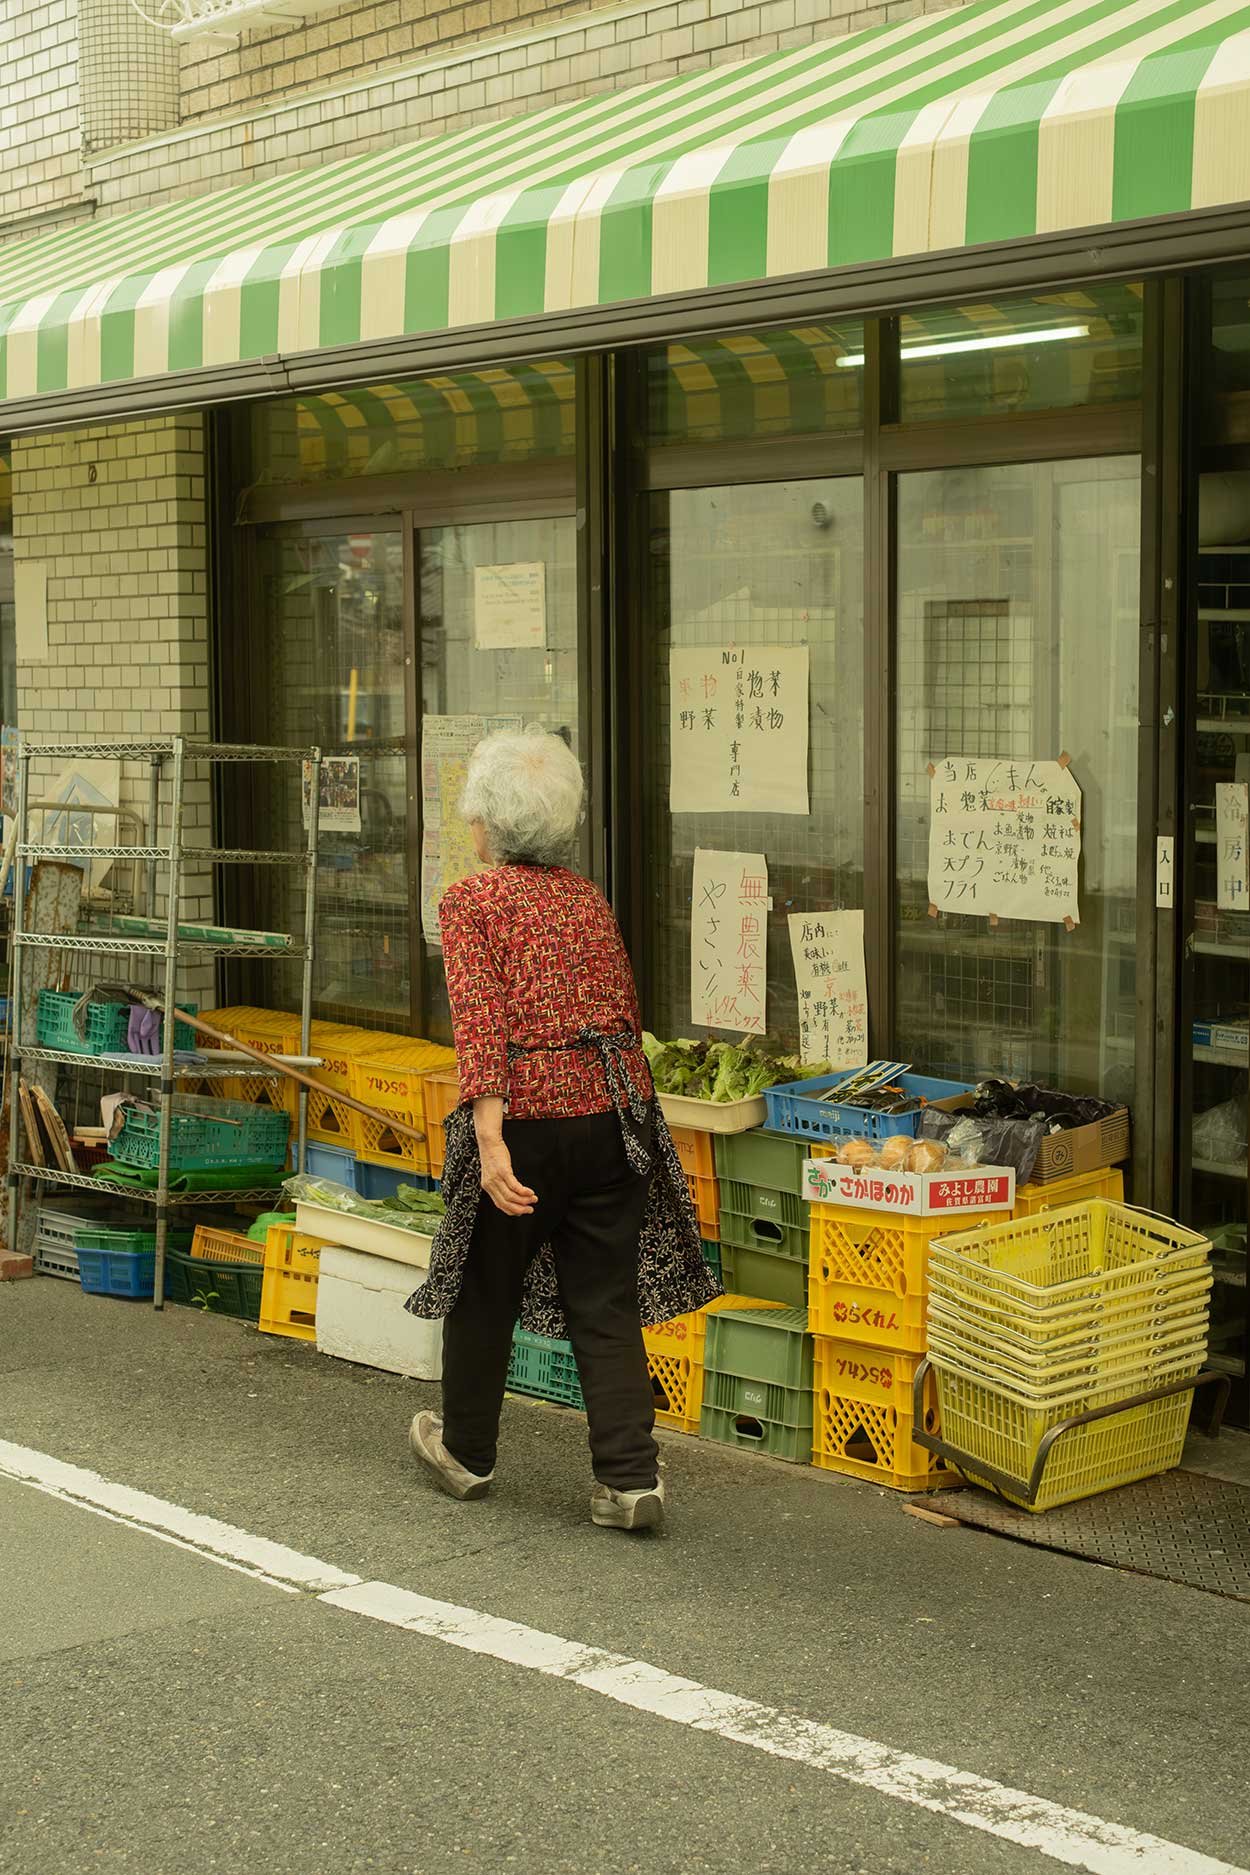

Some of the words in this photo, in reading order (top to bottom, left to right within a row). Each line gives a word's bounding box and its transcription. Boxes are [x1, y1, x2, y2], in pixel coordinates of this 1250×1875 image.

[747, 670, 781, 698] 惣菜
[680, 708, 717, 730] 野菜
[749, 706, 784, 731] 漬物
[729, 740, 741, 797] 専門店
[943, 830, 994, 850] おでん
[1224, 796, 1242, 901] 冷房中
[943, 855, 984, 878] 天プラ
[1160, 850, 1170, 896] 入口
[944, 880, 977, 900] フライ
[736, 868, 768, 1003] 無農薬
[706, 1009, 765, 1030] サニーレタス
[808, 1168, 832, 1198] さが
[840, 1177, 914, 1206] さがほのか
[939, 1179, 999, 1197] みよし農園
[848, 1305, 900, 1331] らくれん
[836, 1358, 881, 1385] らくれん
